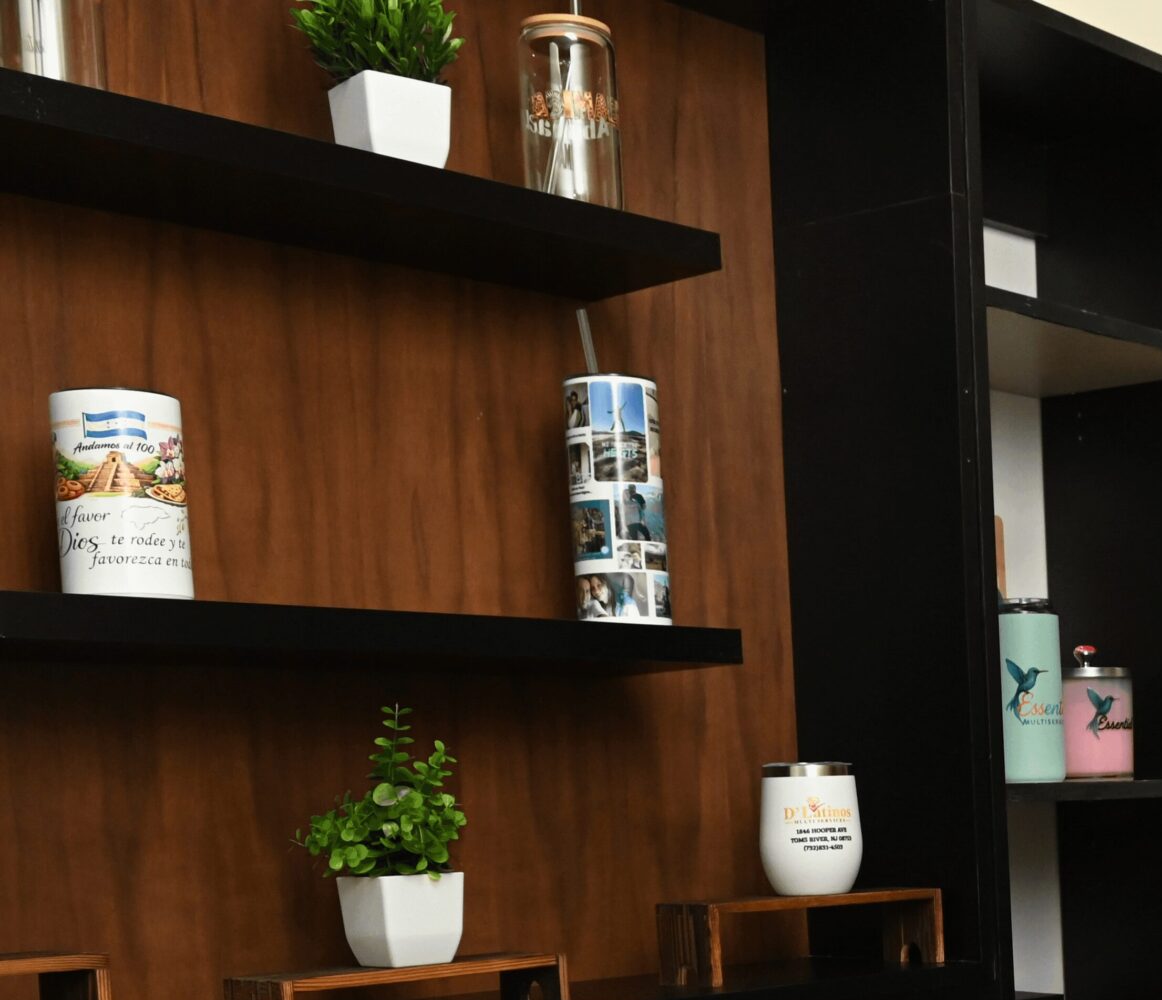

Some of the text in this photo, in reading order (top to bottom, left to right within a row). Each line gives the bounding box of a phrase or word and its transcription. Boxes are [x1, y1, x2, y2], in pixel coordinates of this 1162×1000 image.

[73, 441, 155, 455] Andamos al 100
[71, 505, 111, 529] favor
[59, 528, 186, 558] Dios te rodee y te
[89, 551, 161, 570] favorezca
[166, 557, 178, 567] en
